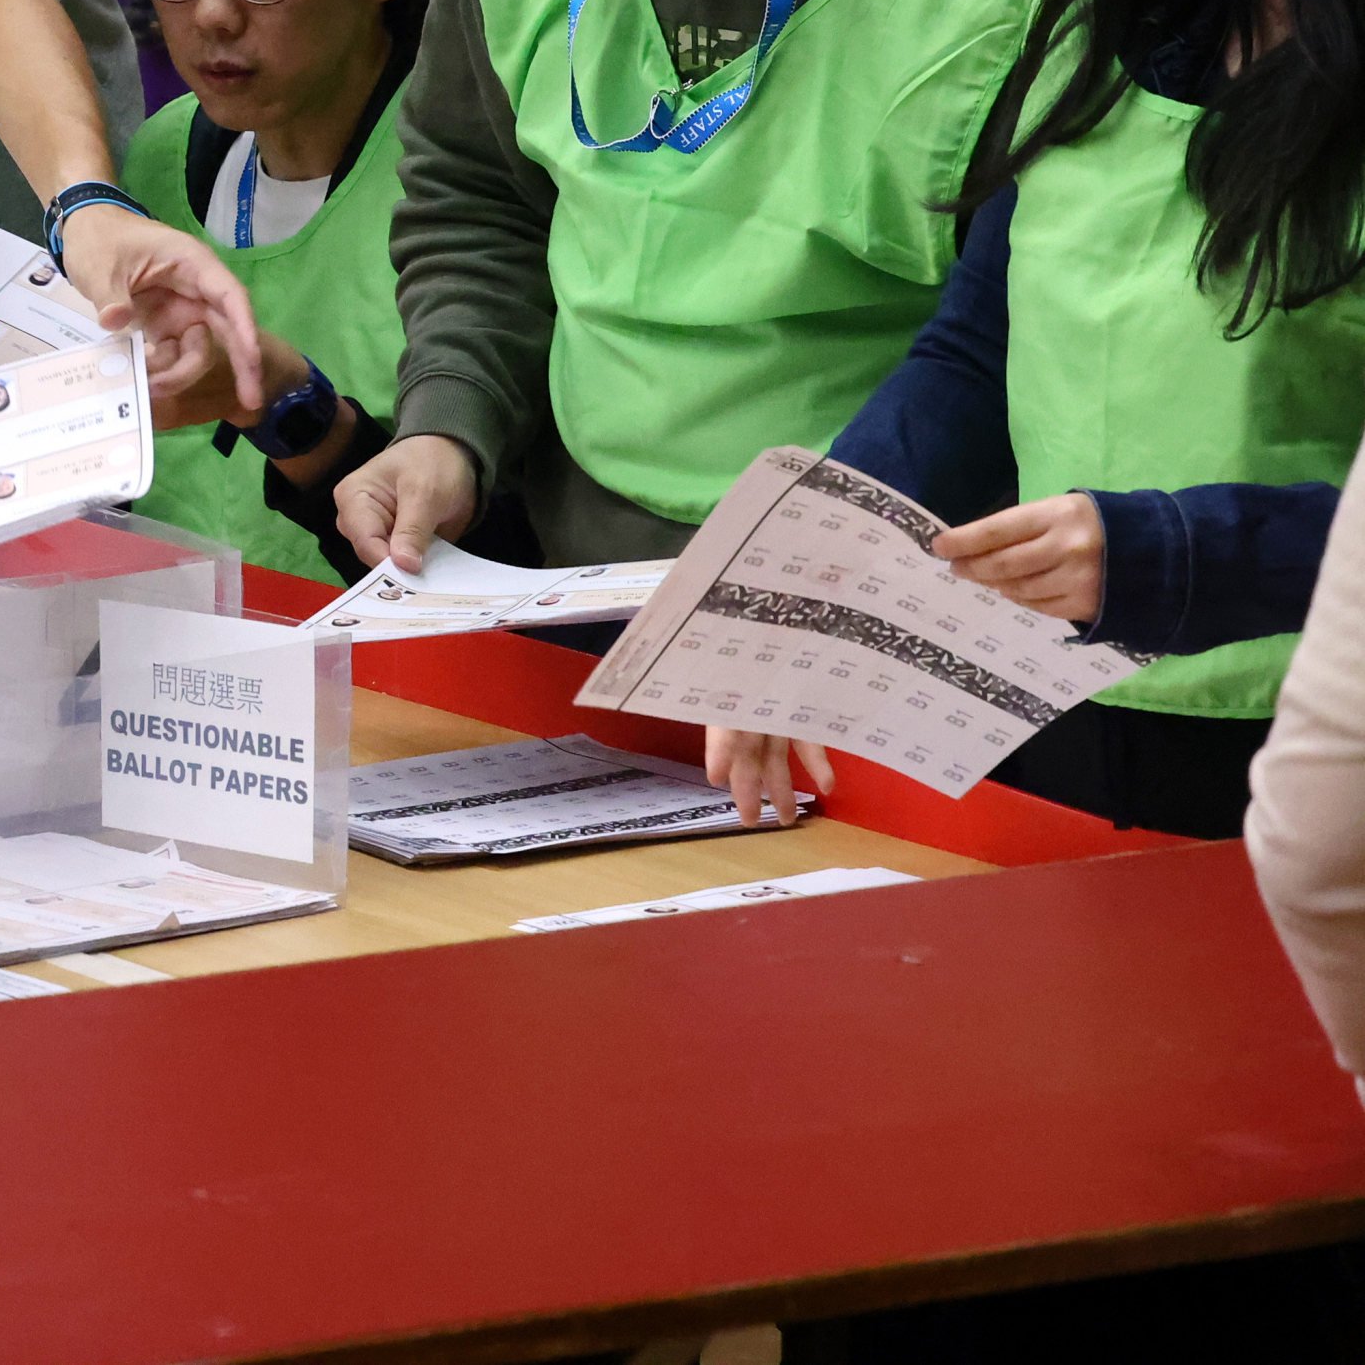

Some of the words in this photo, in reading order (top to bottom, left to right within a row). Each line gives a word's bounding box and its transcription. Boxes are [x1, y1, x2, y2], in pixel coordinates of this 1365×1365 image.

[680, 103, 723, 148] STAFF
[118, 402, 130, 418] 3
[781, 457, 806, 473] B1
[780, 500, 809, 520] B1
[820, 512, 849, 530] B1
[858, 527, 887, 545] B1
[744, 546, 772, 567] B1
[781, 554, 810, 575] B1
[820, 563, 849, 583] B1
[858, 575, 887, 595] B1
[897, 594, 926, 613] B1
[936, 615, 965, 633] B1
[1014, 611, 1043, 628] B1
[680, 631, 708, 650] B1
[718, 638, 746, 656] B1
[975, 635, 1004, 653] B1
[755, 643, 782, 662] B1
[791, 649, 819, 670] B1
[829, 659, 857, 678] B1
[1014, 657, 1042, 674] B1
[152, 662, 263, 716] 問題選票
[642, 680, 671, 699] B1
[867, 673, 897, 692] B1
[1052, 678, 1078, 695] B1
[680, 687, 708, 706] B1
[717, 691, 743, 711] B1
[906, 691, 935, 710] B1
[753, 698, 781, 717] B1
[789, 704, 818, 723] B1
[827, 714, 857, 733] B1
[945, 709, 974, 728] B1
[110, 709, 305, 764] QUESTIONABLE
[865, 727, 895, 747] B1
[984, 727, 1013, 747] B1
[904, 745, 933, 764] B1
[106, 748, 202, 787] BALLOT
[210, 766, 309, 805] PAPERS
[942, 763, 972, 782] B1
